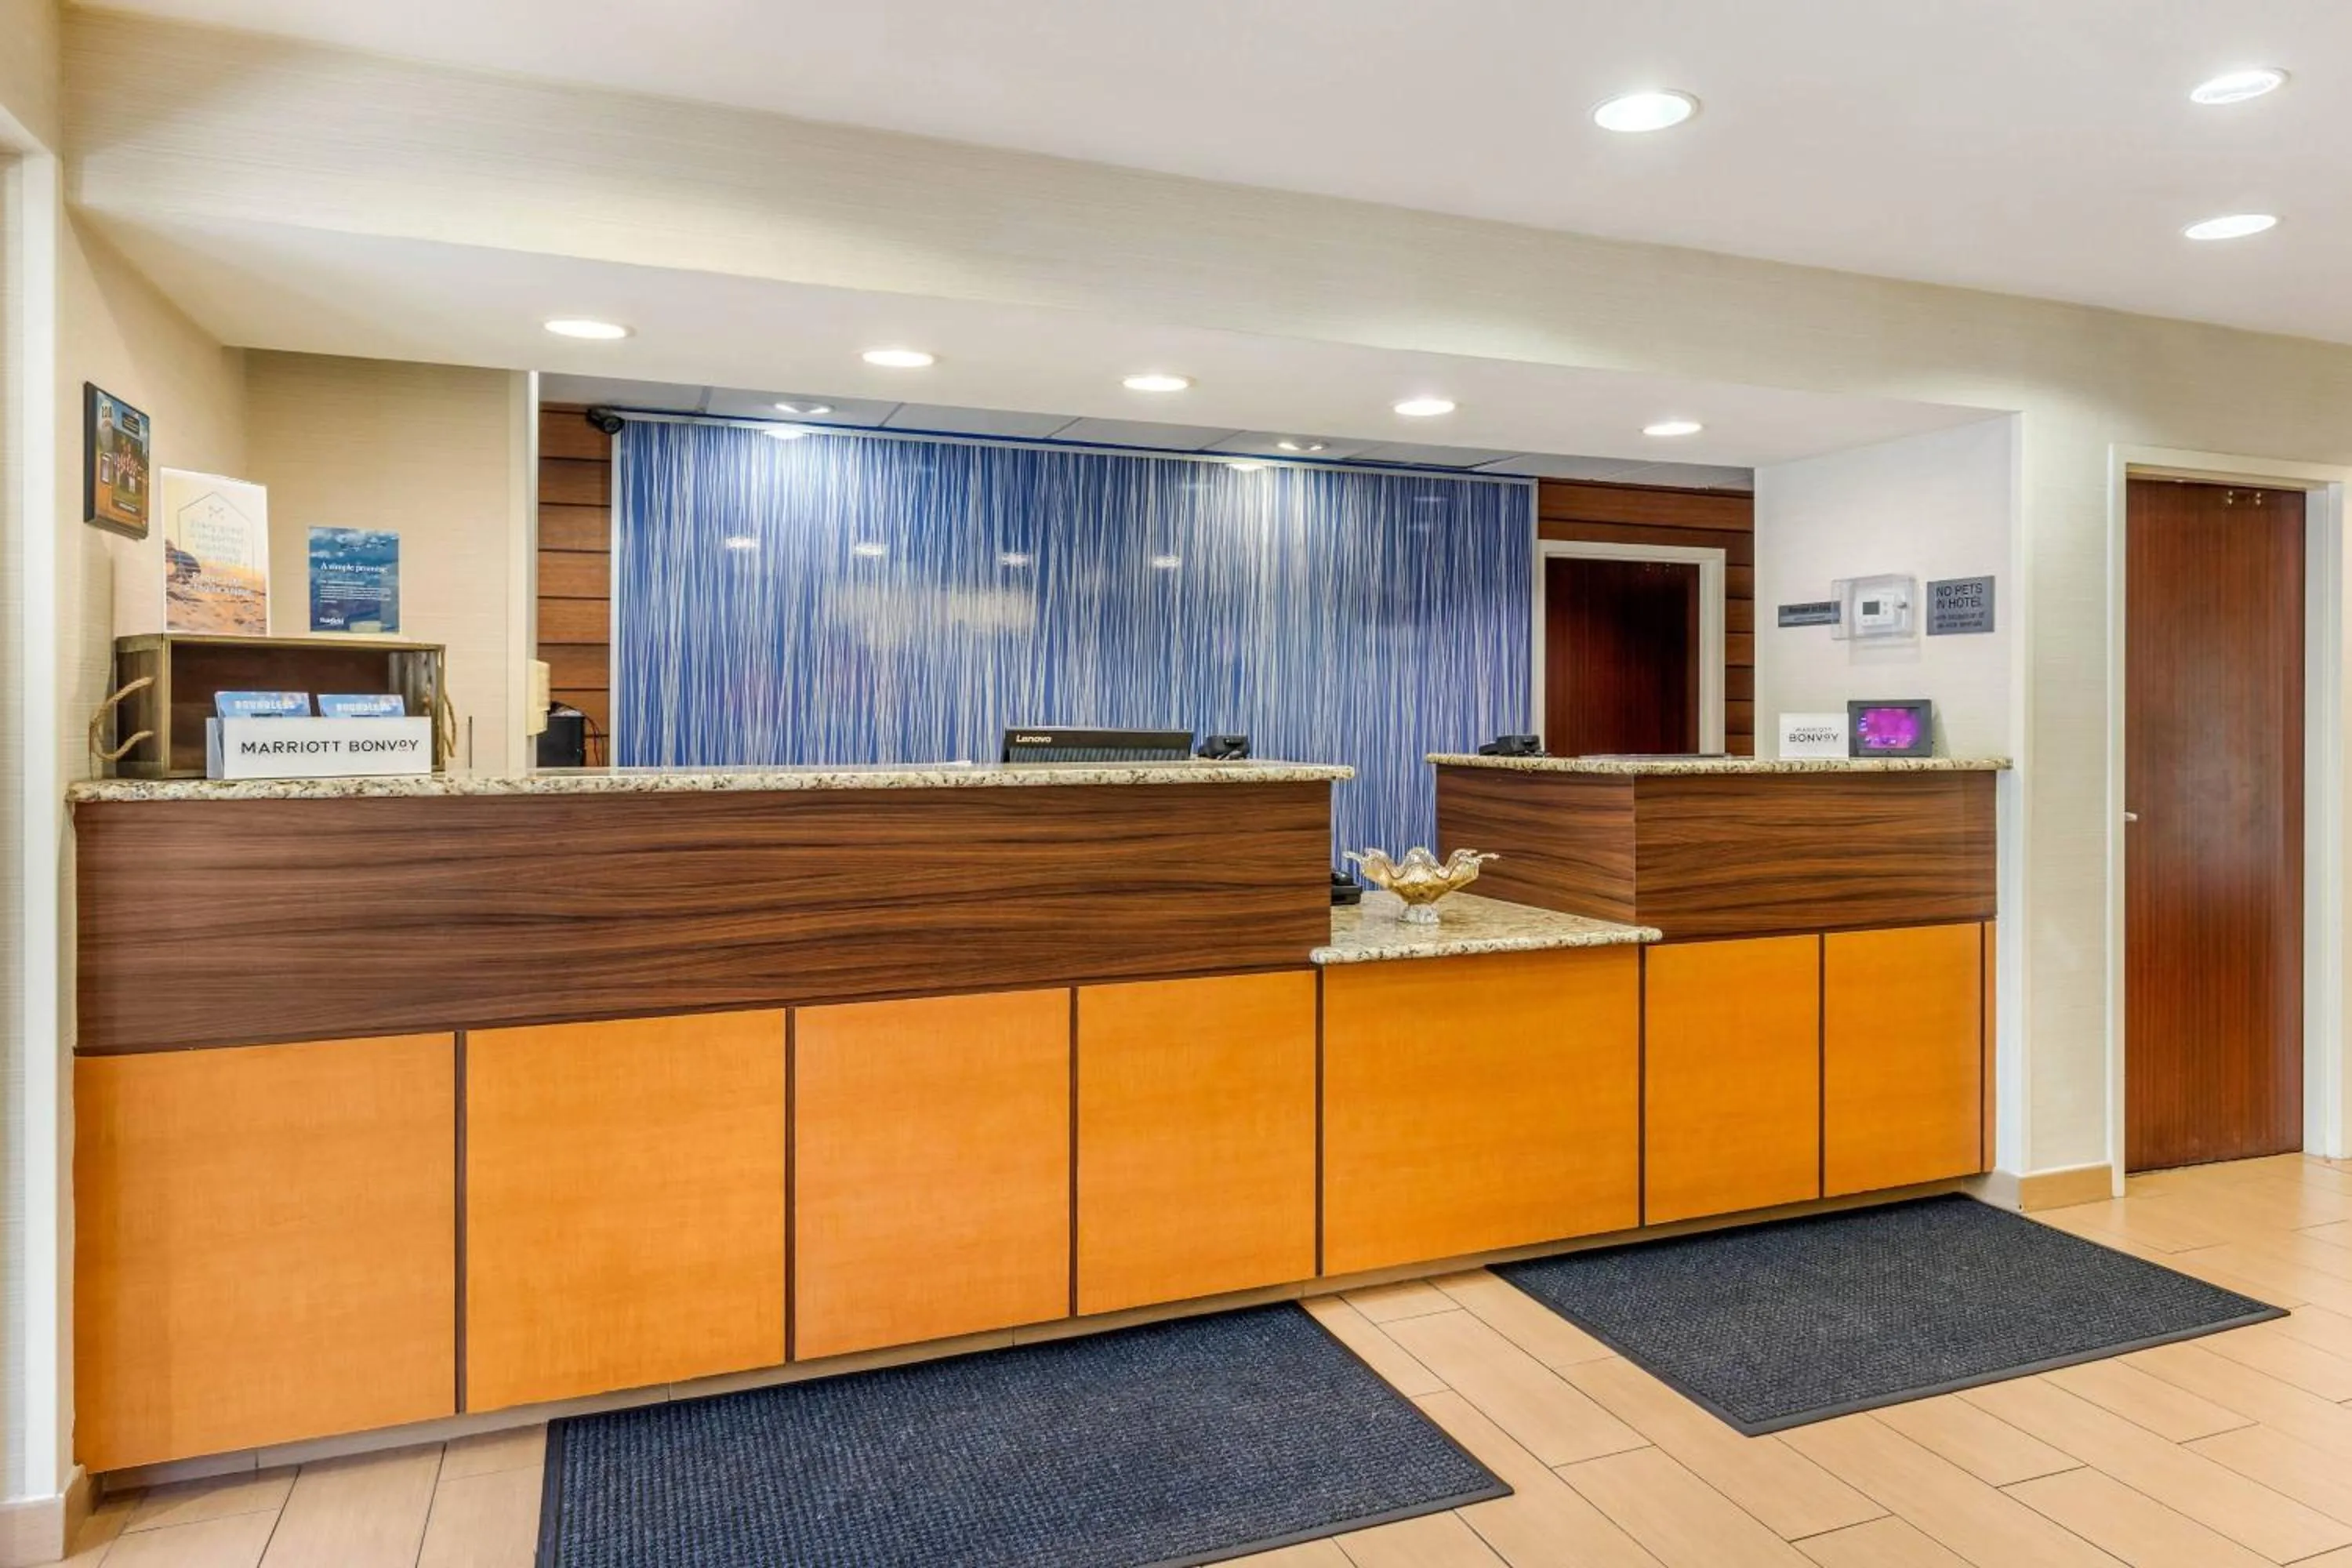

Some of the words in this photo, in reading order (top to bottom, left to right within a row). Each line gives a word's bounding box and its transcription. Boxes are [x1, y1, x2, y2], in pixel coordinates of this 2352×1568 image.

[1936, 586, 1952, 597] NO
[1955, 583, 1982, 595] PETS
[1936, 597, 1945, 609] IN
[1948, 596, 1982, 609] HOTEL
[1015, 734, 1051, 743] Lenovo
[1788, 733, 1839, 742] BONVOY
[241, 740, 341, 753] MARRIOTT
[349, 739, 419, 753] BONVOY
